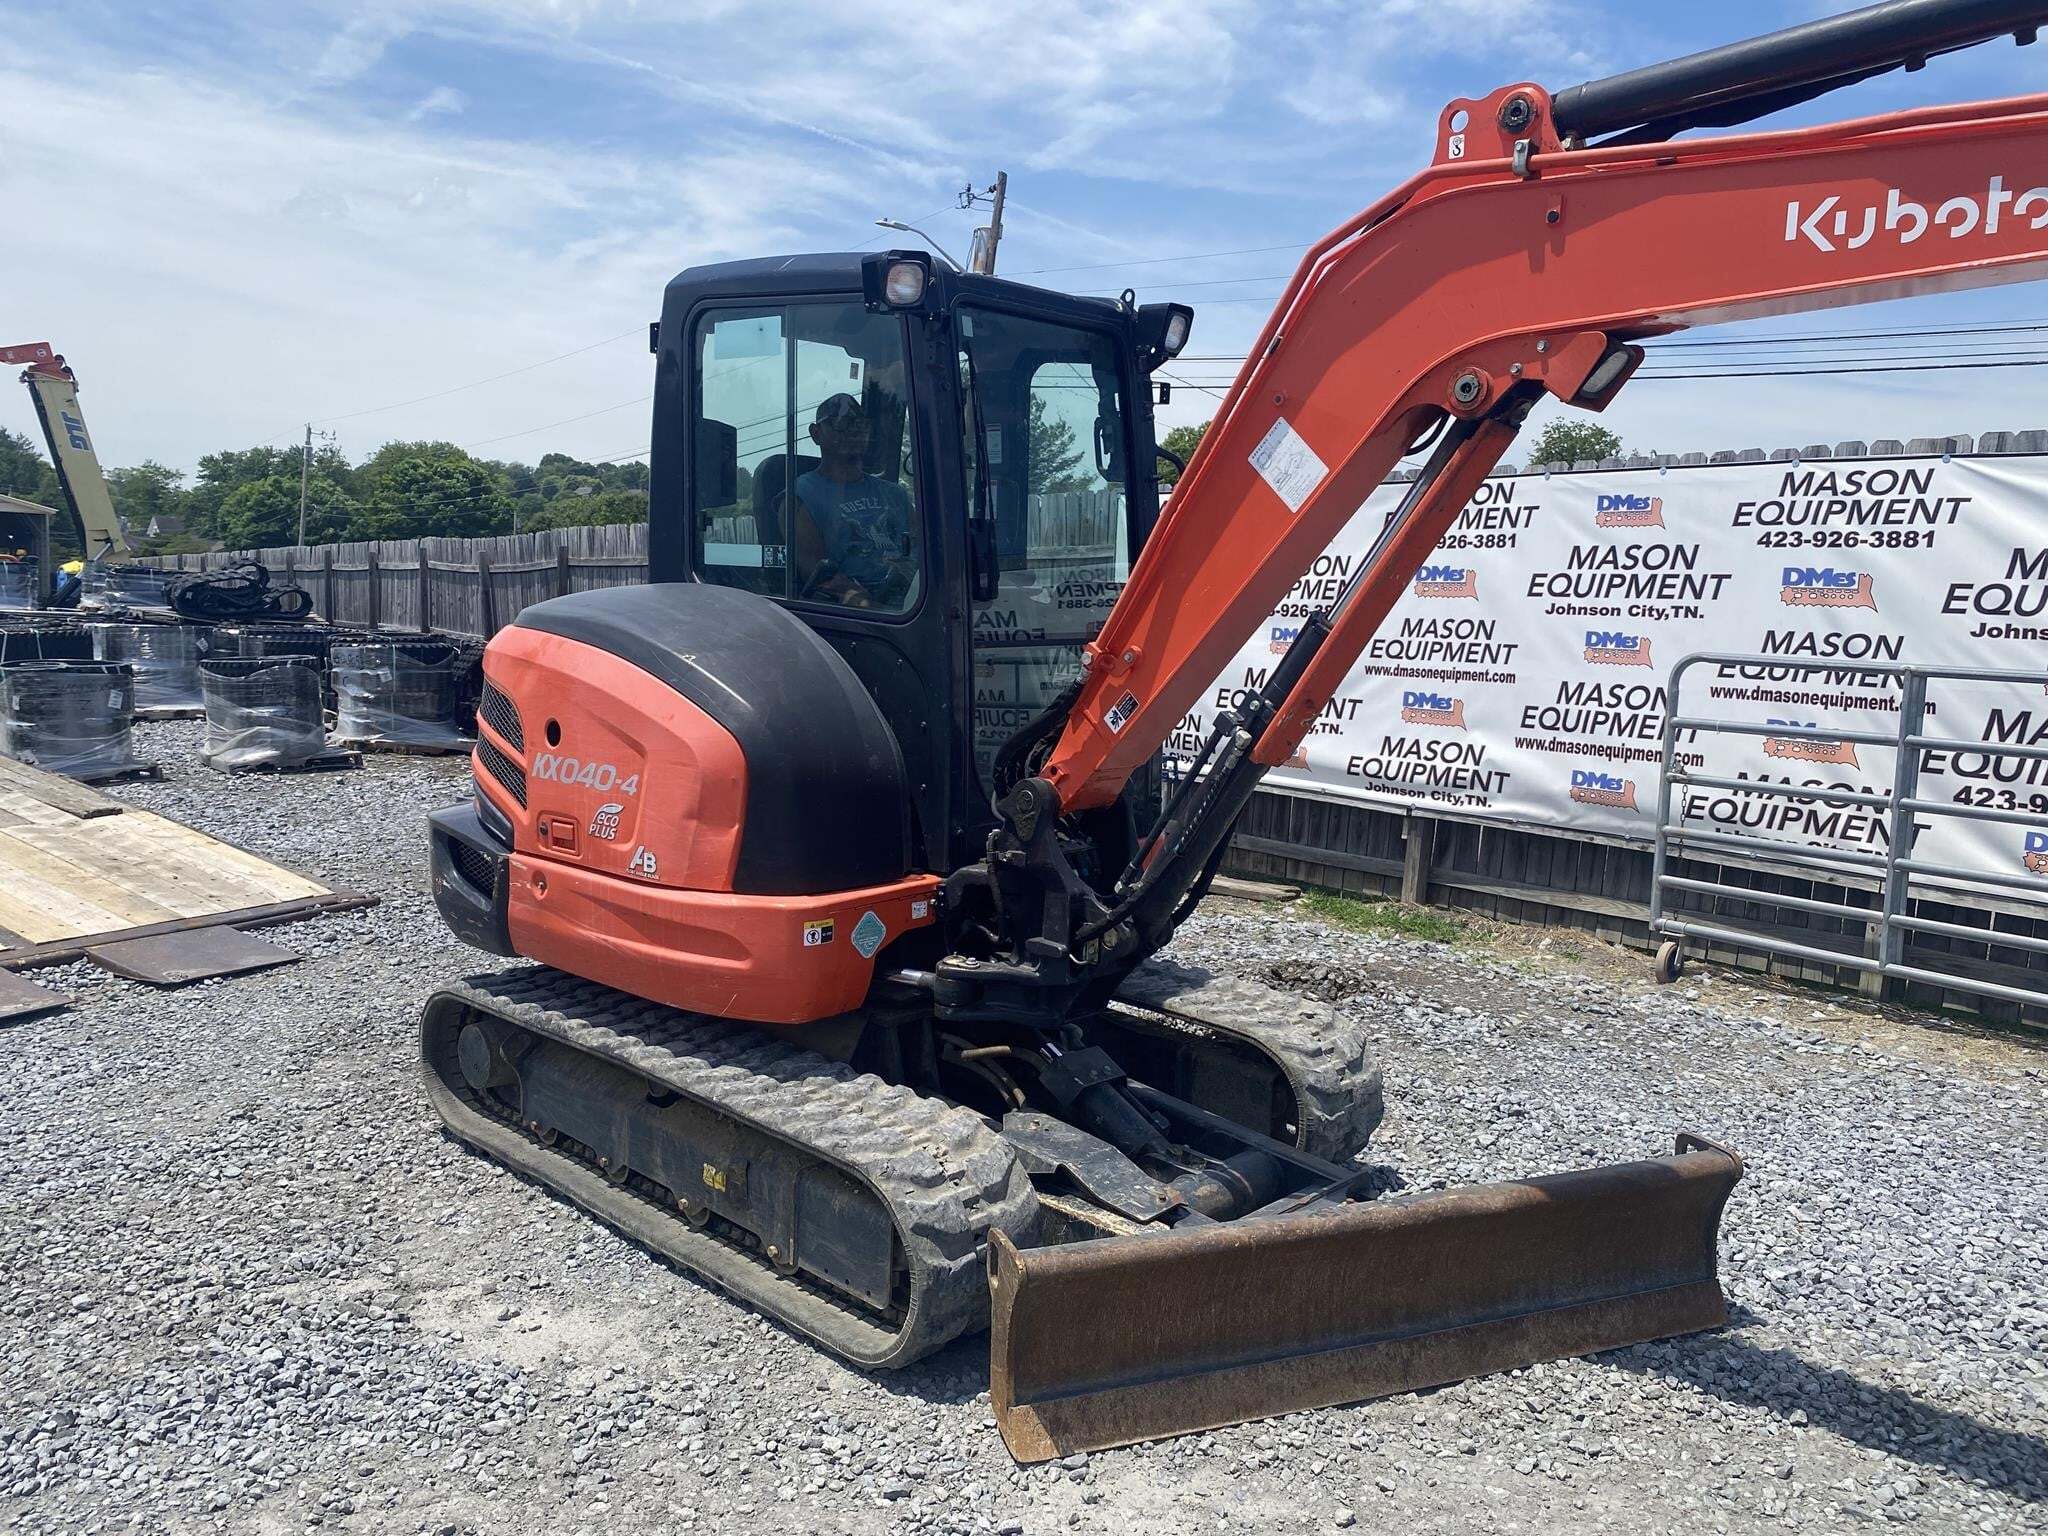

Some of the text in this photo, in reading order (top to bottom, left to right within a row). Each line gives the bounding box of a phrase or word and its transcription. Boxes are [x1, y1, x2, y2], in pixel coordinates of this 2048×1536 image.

[1779, 468, 1935, 498] MASON
[1732, 497, 1972, 527] EQUIPMENT
[1436, 533, 1517, 549] 926-3881
[1757, 530, 1935, 548] 423-926-3881
[1567, 544, 1700, 570] MASON
[1527, 573, 1732, 600] EQUIPMENT
[1544, 603, 1704, 621] Johnson City,TN.
[1400, 618, 1496, 640] MASON
[1969, 623, 2048, 640] Johns
[1369, 639, 1518, 665] EQUIPMENT
[1761, 630, 1904, 660] MASON
[1364, 664, 1516, 684] www.dmasonequipment.com
[1717, 664, 1905, 690] EQUIPMEN
[1556, 681, 1667, 711] MASON
[1710, 685, 1936, 715] www.dmasonequipment.m
[1379, 736, 1486, 767] MASON
[1514, 736, 1704, 767] www.dmasonequipmencom
[531, 752, 639, 796] KX040-4
[1346, 756, 1510, 794] EQUIPMENT
[1364, 782, 1492, 808] Johnson City,TN.
[588, 825, 618, 840] PLUS
[597, 812, 620, 827] eco
[629, 845, 657, 874] AB
